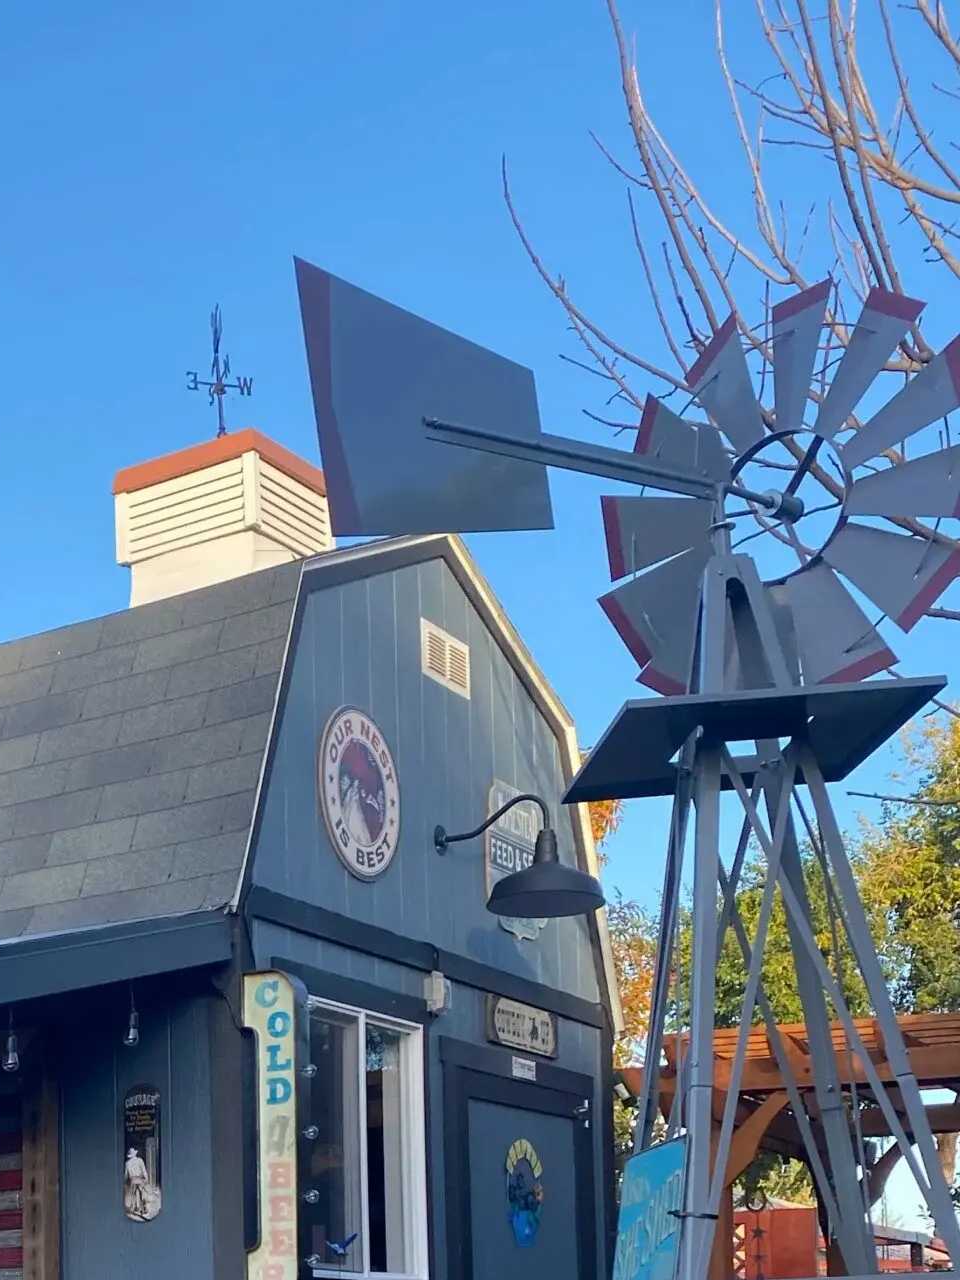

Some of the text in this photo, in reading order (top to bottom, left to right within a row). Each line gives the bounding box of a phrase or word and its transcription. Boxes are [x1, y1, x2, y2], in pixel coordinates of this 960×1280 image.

[236, 376, 253, 396] W
[329, 718, 395, 784] OUR NEST
[336, 816, 392, 869] IS BEST
[490, 839, 514, 870] FEED
[515, 848, 522, 872] &
[253, 979, 292, 1106] COLD
